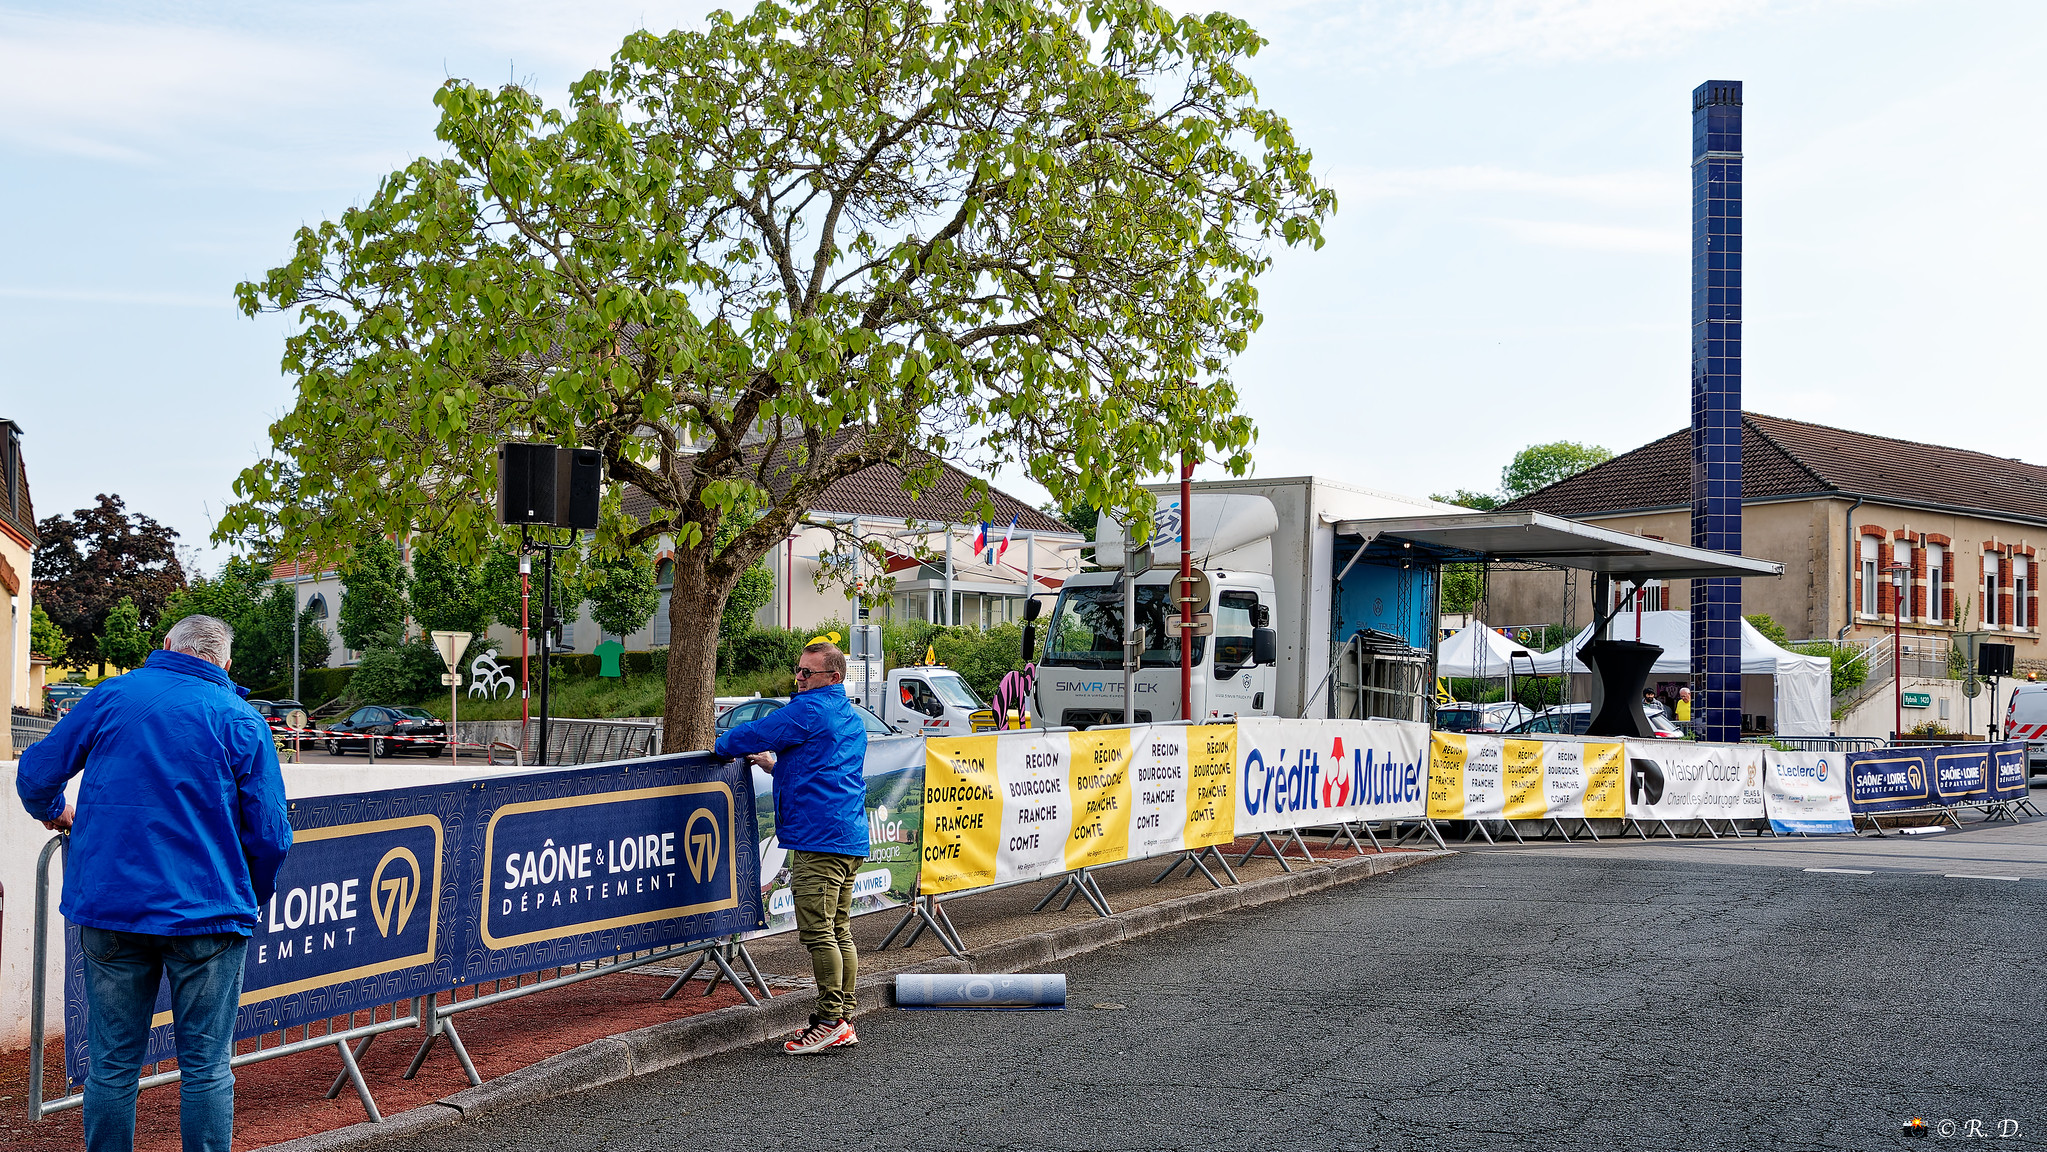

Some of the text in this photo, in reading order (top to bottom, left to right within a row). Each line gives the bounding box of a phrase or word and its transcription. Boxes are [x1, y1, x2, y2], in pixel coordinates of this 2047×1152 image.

[1138, 766, 1181, 782] BOURGOGNE
[1194, 763, 1231, 778] BOURGOGNE
[1666, 760, 1740, 781] Maison Doucet
[1856, 772, 1884, 787] SAÔNE
[1886, 772, 1907, 785] LOIRE
[1009, 778, 1061, 797] BOURGOGNE
[1078, 771, 1124, 790] BOURGOGNE
[1244, 748, 1422, 816] Crédit Mutuel
[927, 785, 993, 803] BOURGOGNE
[1142, 790, 1175, 805] FRANCHE
[1198, 785, 1227, 800] FRANCHE
[1668, 792, 1740, 808] Charolles Bourgogne
[1018, 806, 1057, 824] FRANCHE
[1086, 796, 1118, 815] FRANCHE
[935, 813, 984, 832] FRANCHE
[504, 832, 675, 890] SAÔNE & LOIRE
[503, 873, 675, 915] DÉPARTEMENT
[773, 898, 783, 910] LA
[863, 877, 883, 892] VIVRE
[268, 878, 358, 934] LOIRE
